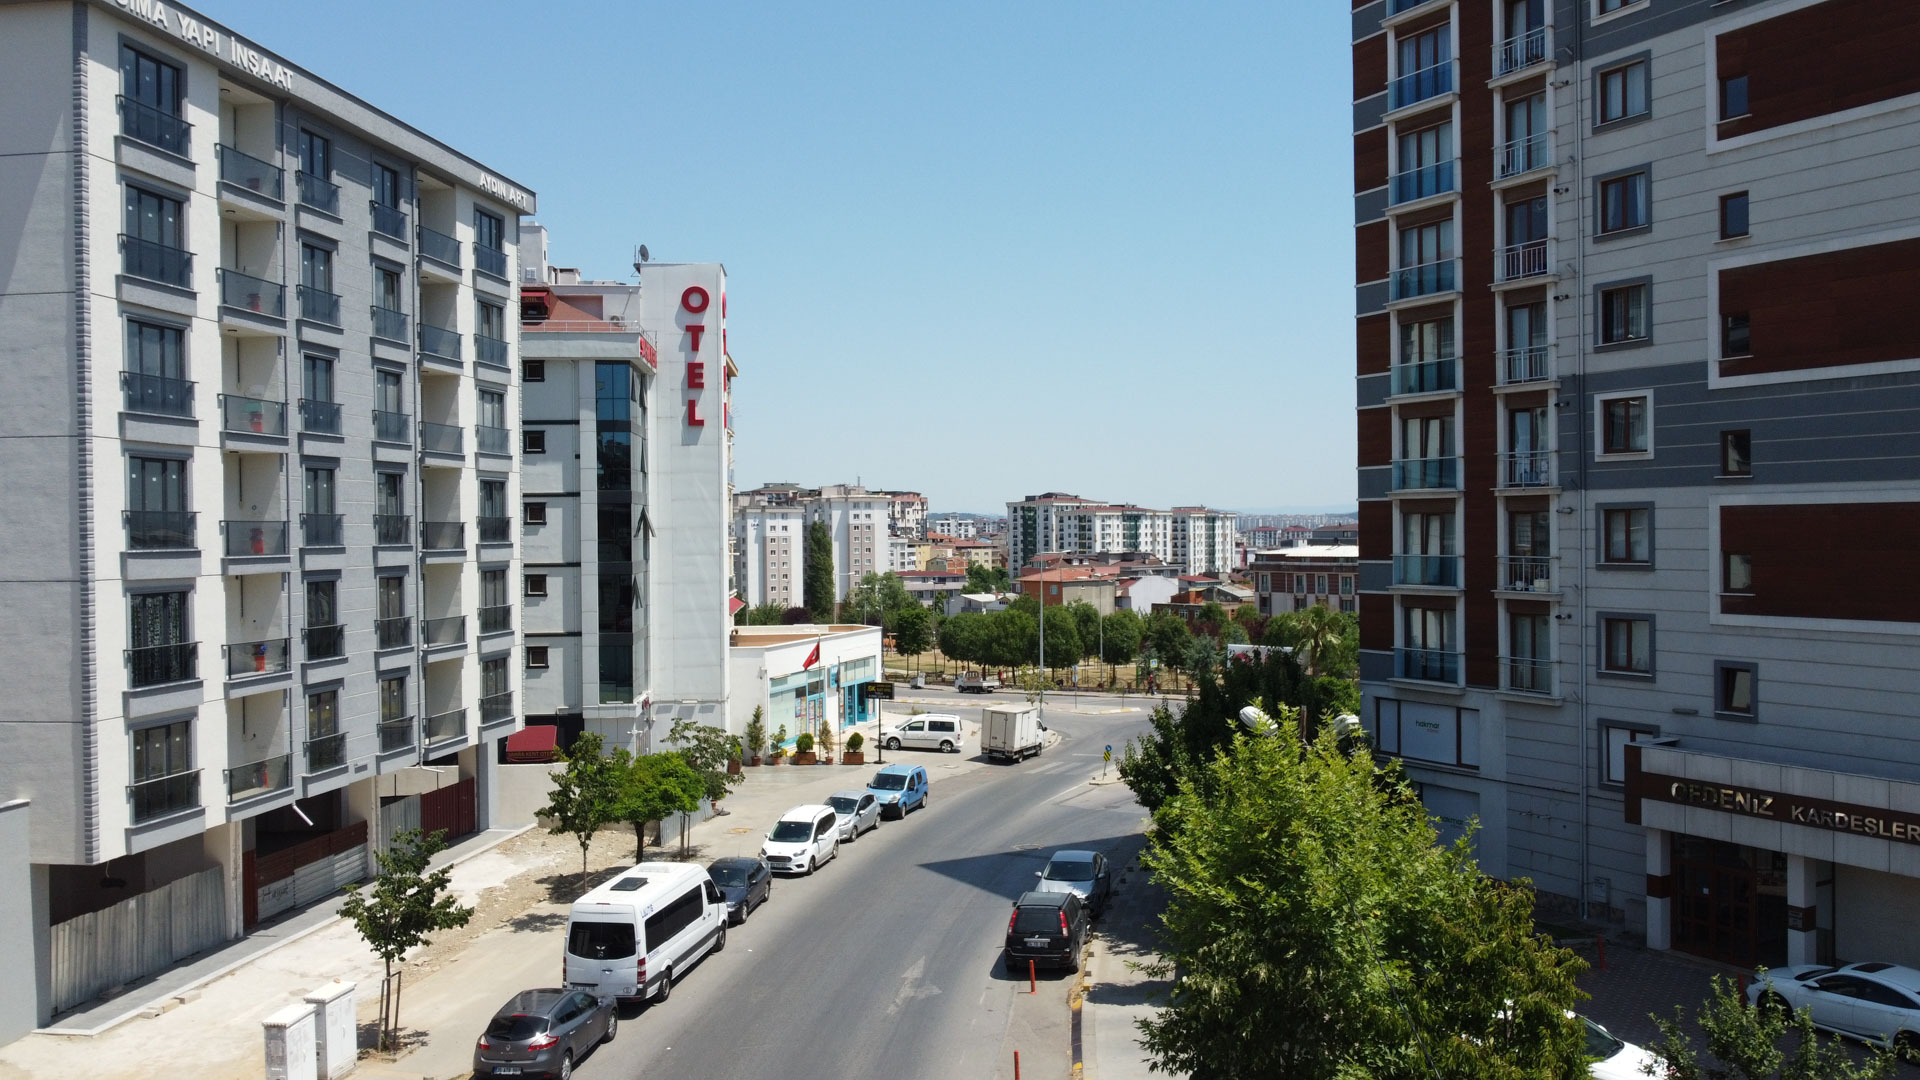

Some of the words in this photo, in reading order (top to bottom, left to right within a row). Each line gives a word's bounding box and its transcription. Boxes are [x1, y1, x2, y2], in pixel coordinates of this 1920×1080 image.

[176, 12, 220, 54] YAPI
[231, 36, 294, 90] İNŞAAT
[480, 172, 506, 197] AYDIN
[509, 188, 527, 207] APT
[681, 286, 710, 427] OTEL
[1791, 804, 1920, 842] KARDEŞLER
